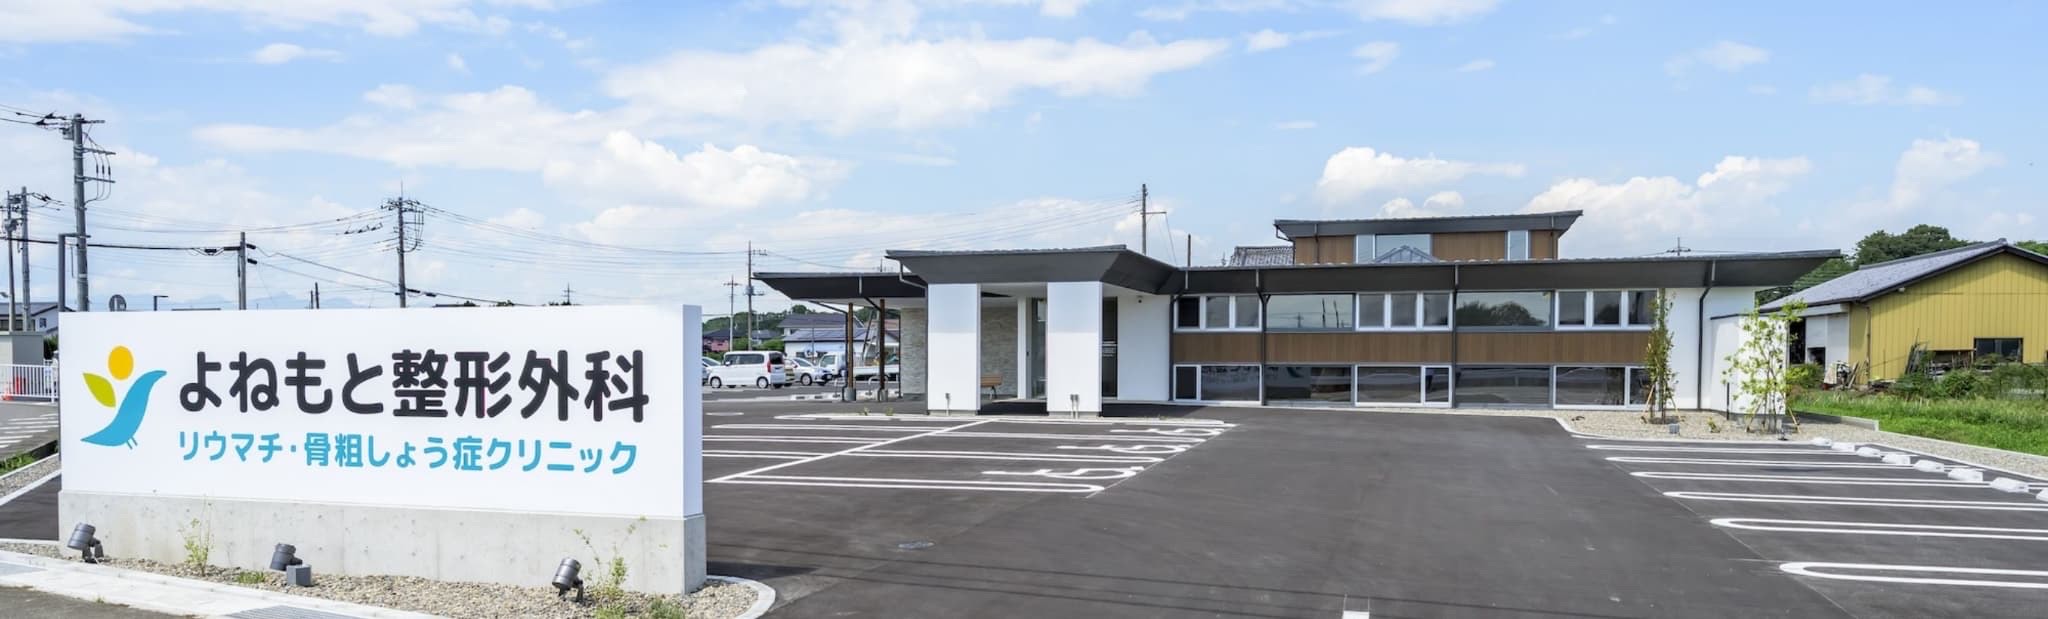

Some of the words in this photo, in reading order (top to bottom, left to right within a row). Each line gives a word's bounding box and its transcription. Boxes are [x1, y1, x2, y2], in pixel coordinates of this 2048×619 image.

[179, 349, 649, 423] よねもと整形外科
[179, 430, 637, 475] リウマチ・骨粗しょう症クリニック
